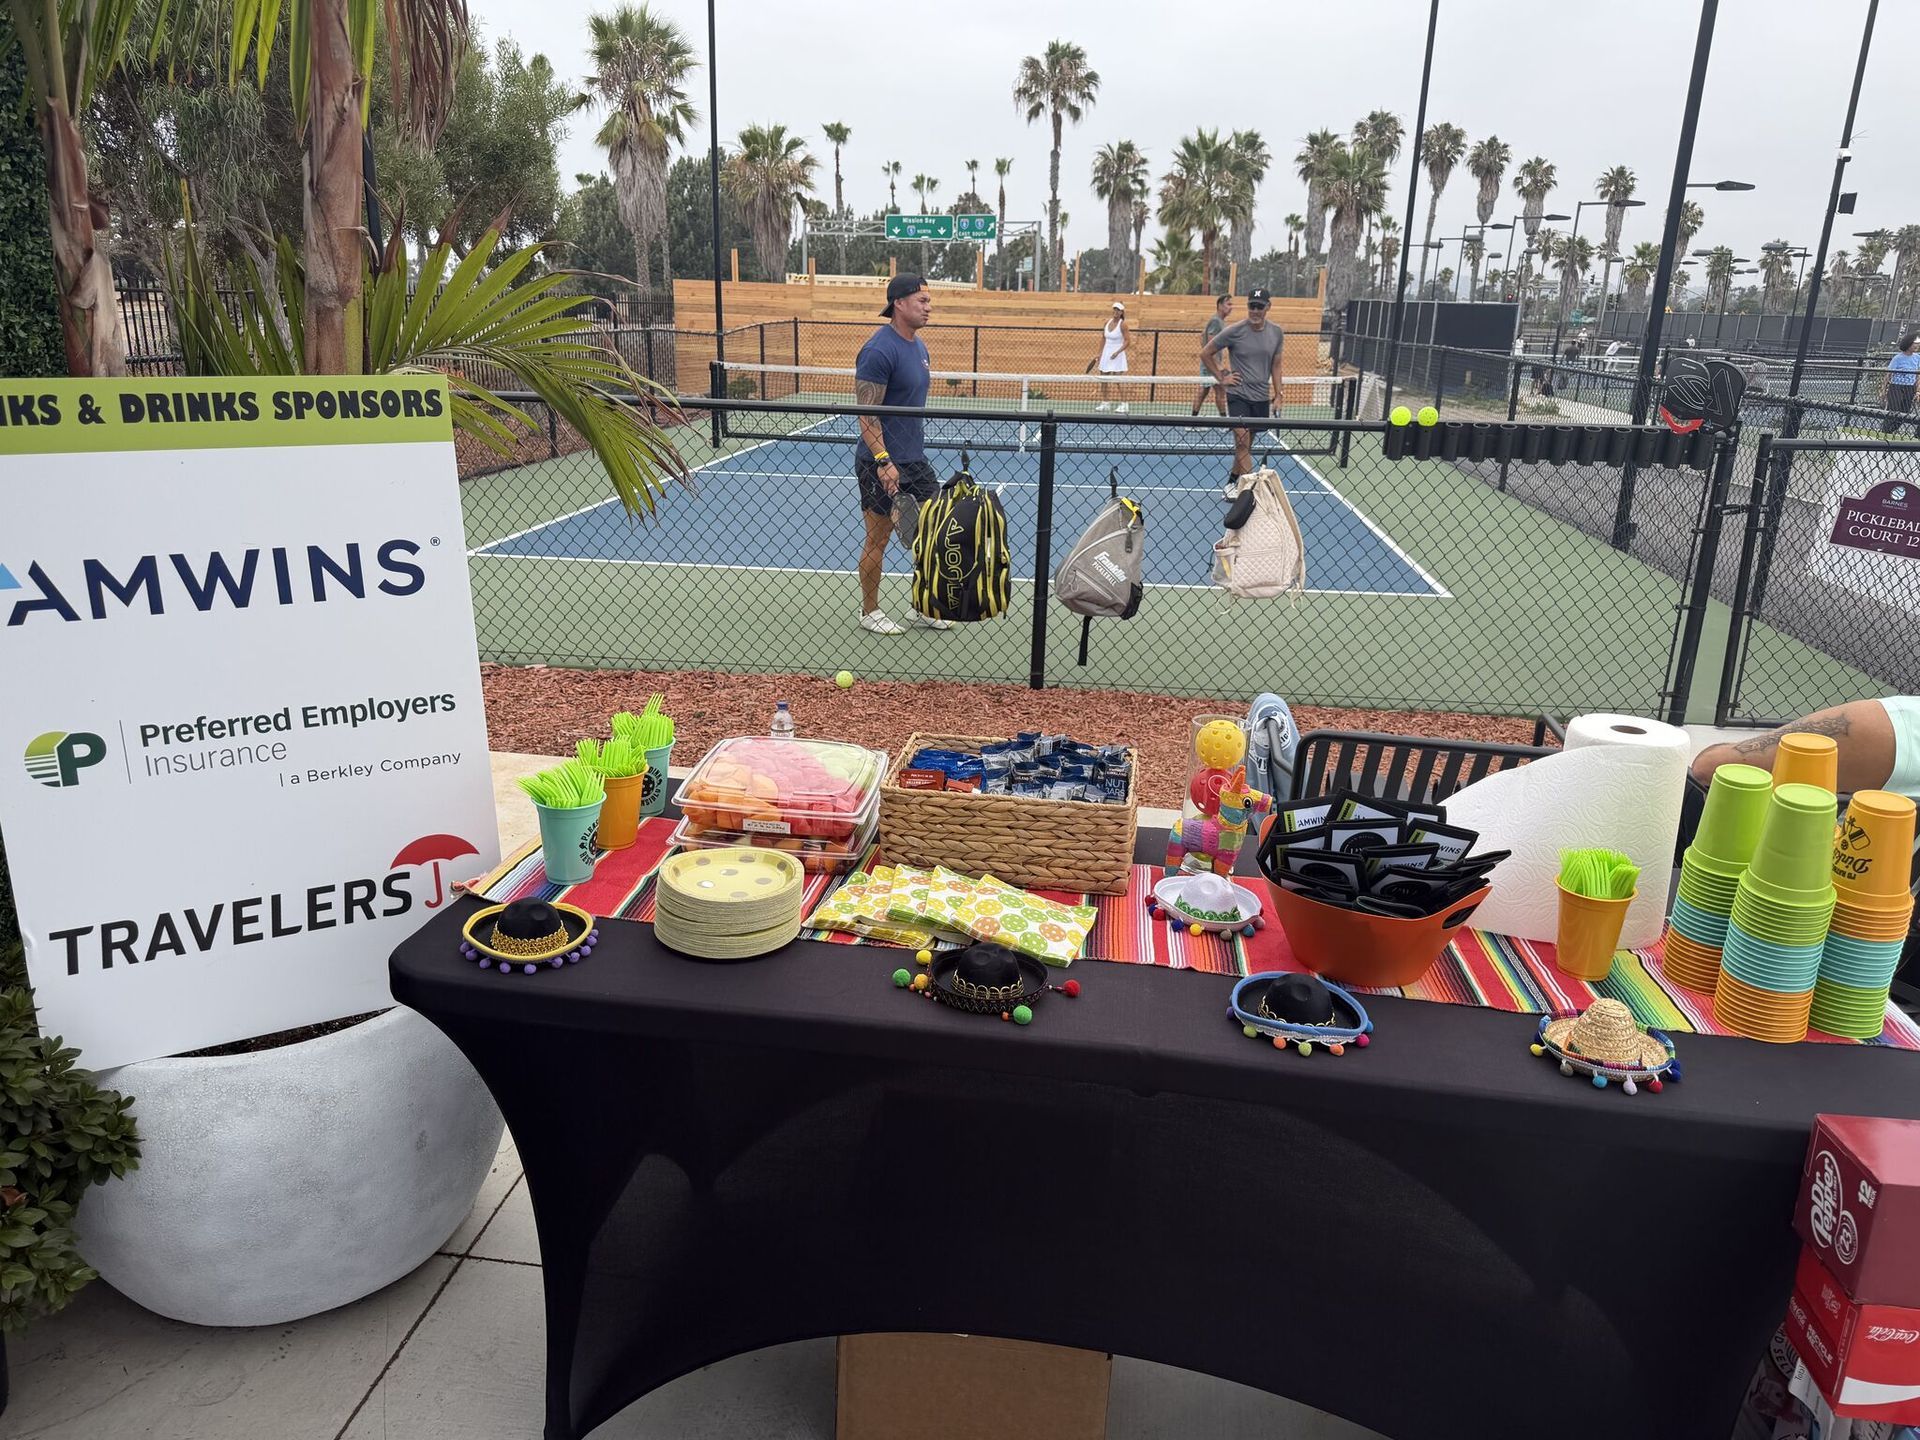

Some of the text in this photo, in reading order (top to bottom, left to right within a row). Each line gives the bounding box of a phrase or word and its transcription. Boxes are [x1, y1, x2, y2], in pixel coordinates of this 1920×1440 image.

[925, 217, 936, 225] Bay
[77, 393, 106, 424] &
[120, 391, 259, 424] DRINKS
[273, 389, 443, 420] SPONSORS
[1849, 526, 1920, 547] COURT 12
[1091, 561, 1117, 586] PICKLEBALL
[1094, 551, 1127, 582] Franklin
[7, 539, 426, 627] AMWINS
[139, 692, 457, 748] Preferred Employers
[145, 741, 288, 777] Insurance
[290, 751, 461, 785] a Berkley Company
[1105, 778, 1126, 789] NUT
[1298, 816, 1327, 827] AMWIN
[1440, 845, 1461, 854] WINS
[49, 871, 413, 976] TRAVELERS
[1811, 1171, 1825, 1209] Dr
[1811, 1157, 1837, 1246] Pepper
[1858, 1180, 1872, 1208] 12
[1840, 1228, 1852, 1252] 23
[1864, 1325, 1919, 1344] Coca-Cola
